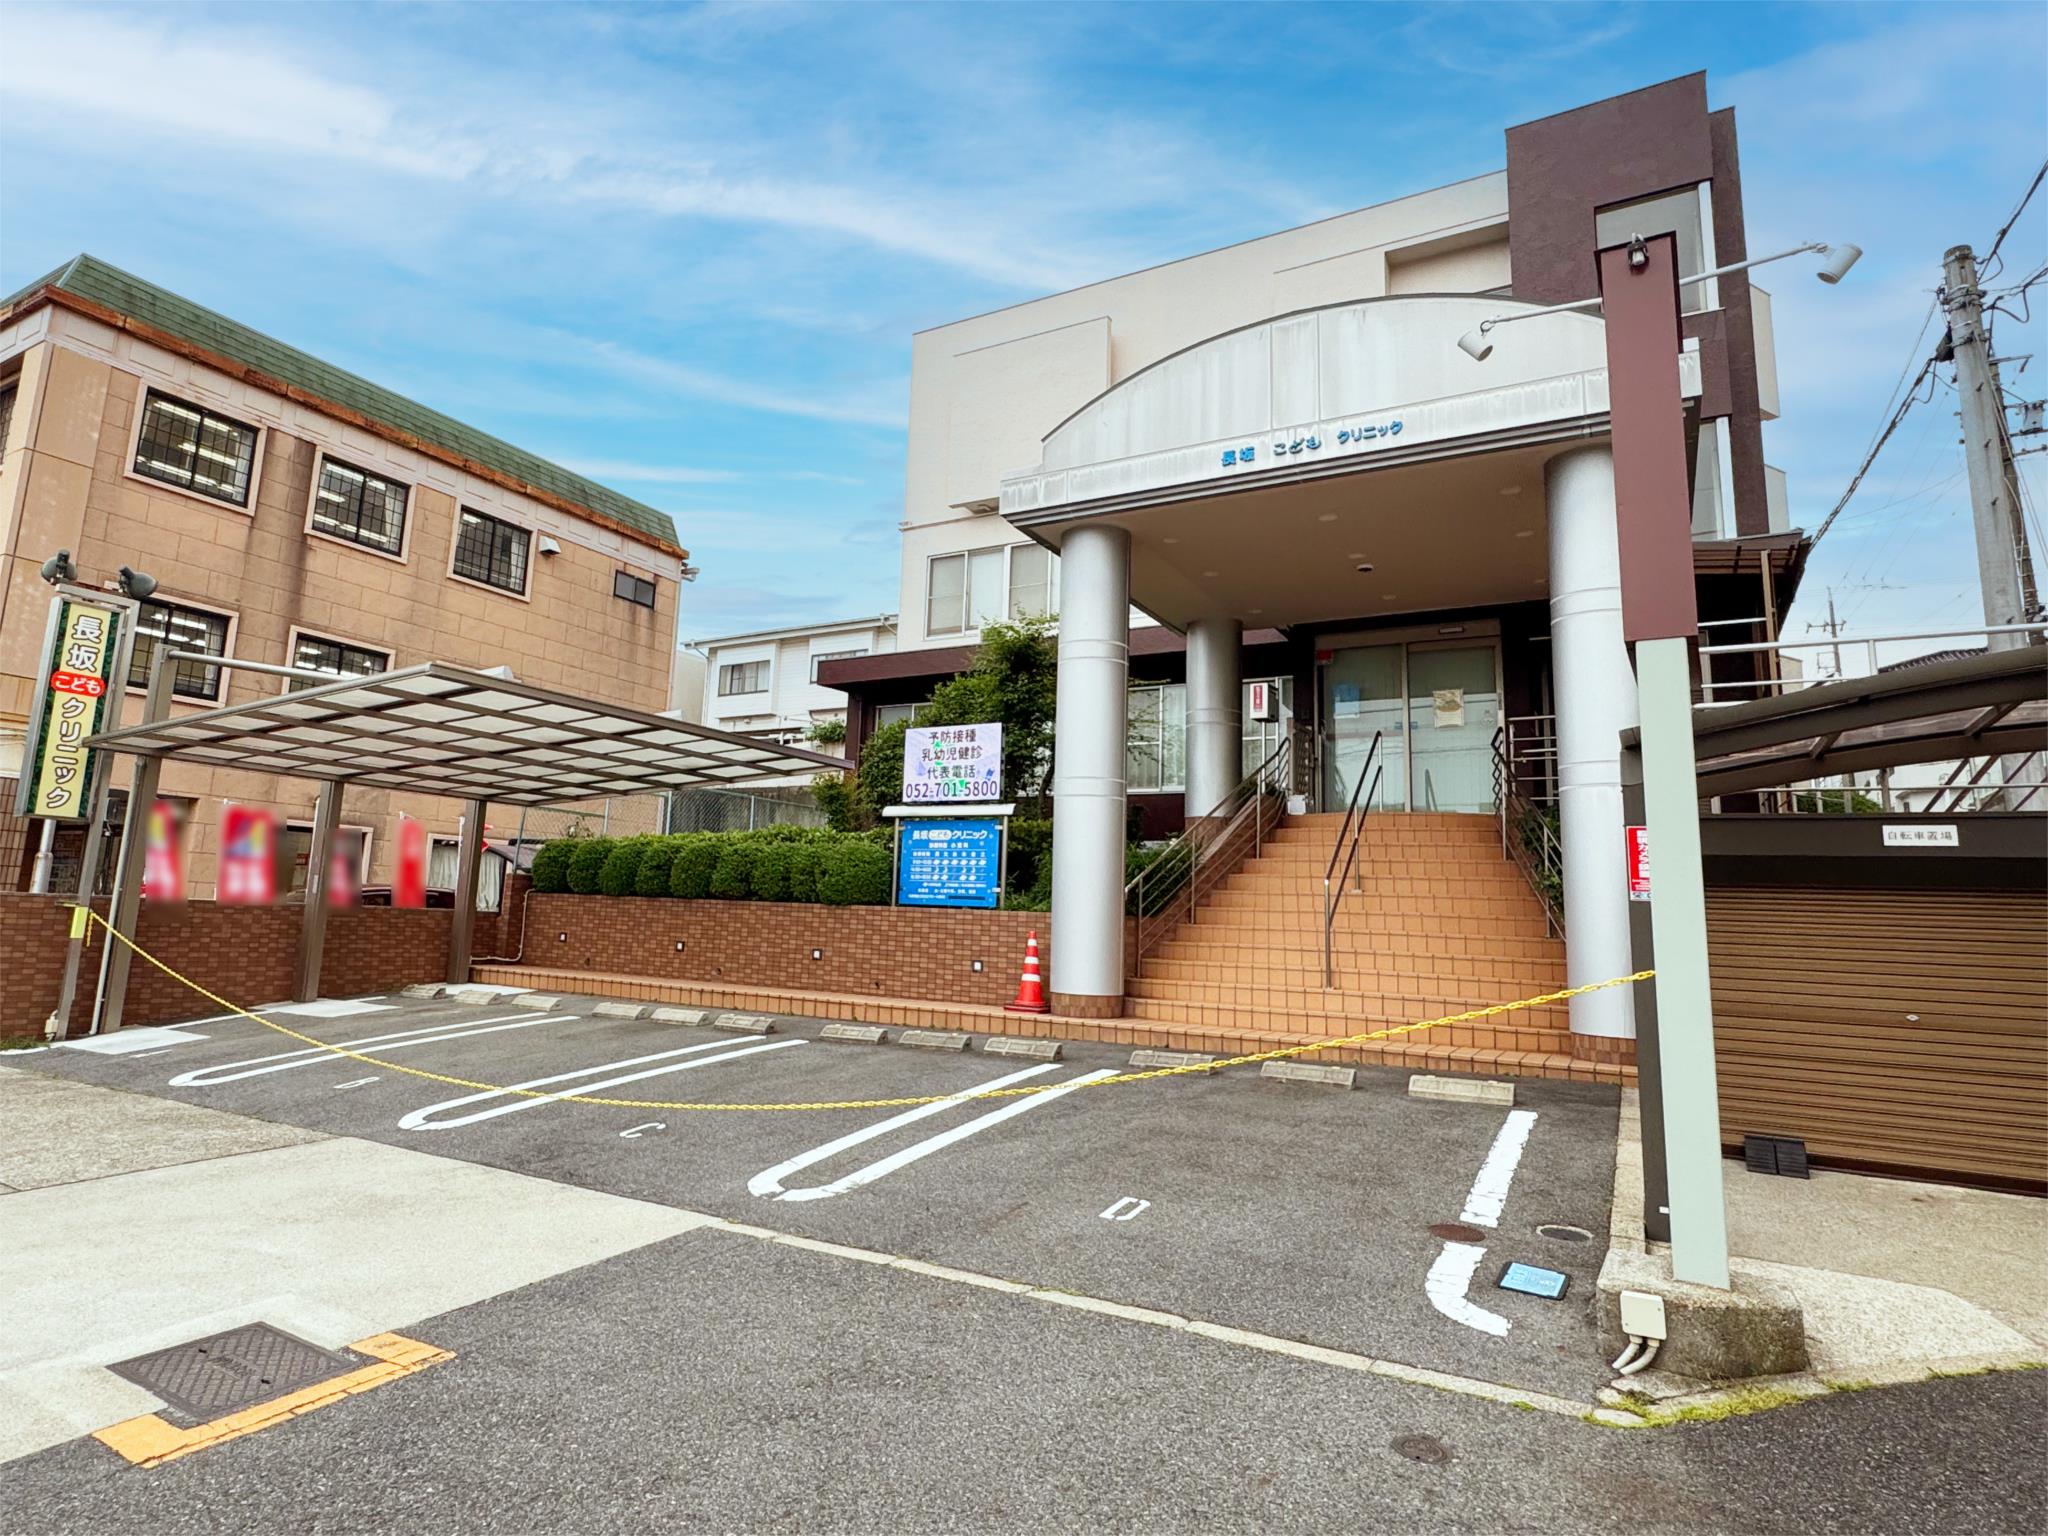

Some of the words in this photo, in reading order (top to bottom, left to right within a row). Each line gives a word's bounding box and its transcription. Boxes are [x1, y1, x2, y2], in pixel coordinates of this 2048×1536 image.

[1273, 436, 1322, 457] こども
[1337, 420, 1404, 445] クリニック
[67, 615, 104, 673] 長坂
[54, 674, 101, 695] こども
[928, 728, 977, 745] 予防接種
[46, 697, 86, 809] クリニック
[921, 746, 983, 762] 乳幼児健診
[927, 765, 976, 780] 代表電話
[905, 780, 998, 799] 052-701-5800
[1887, 831, 1953, 841] 自転車置場
[619, 1122, 666, 1139] C
[1098, 1196, 1151, 1221] D
